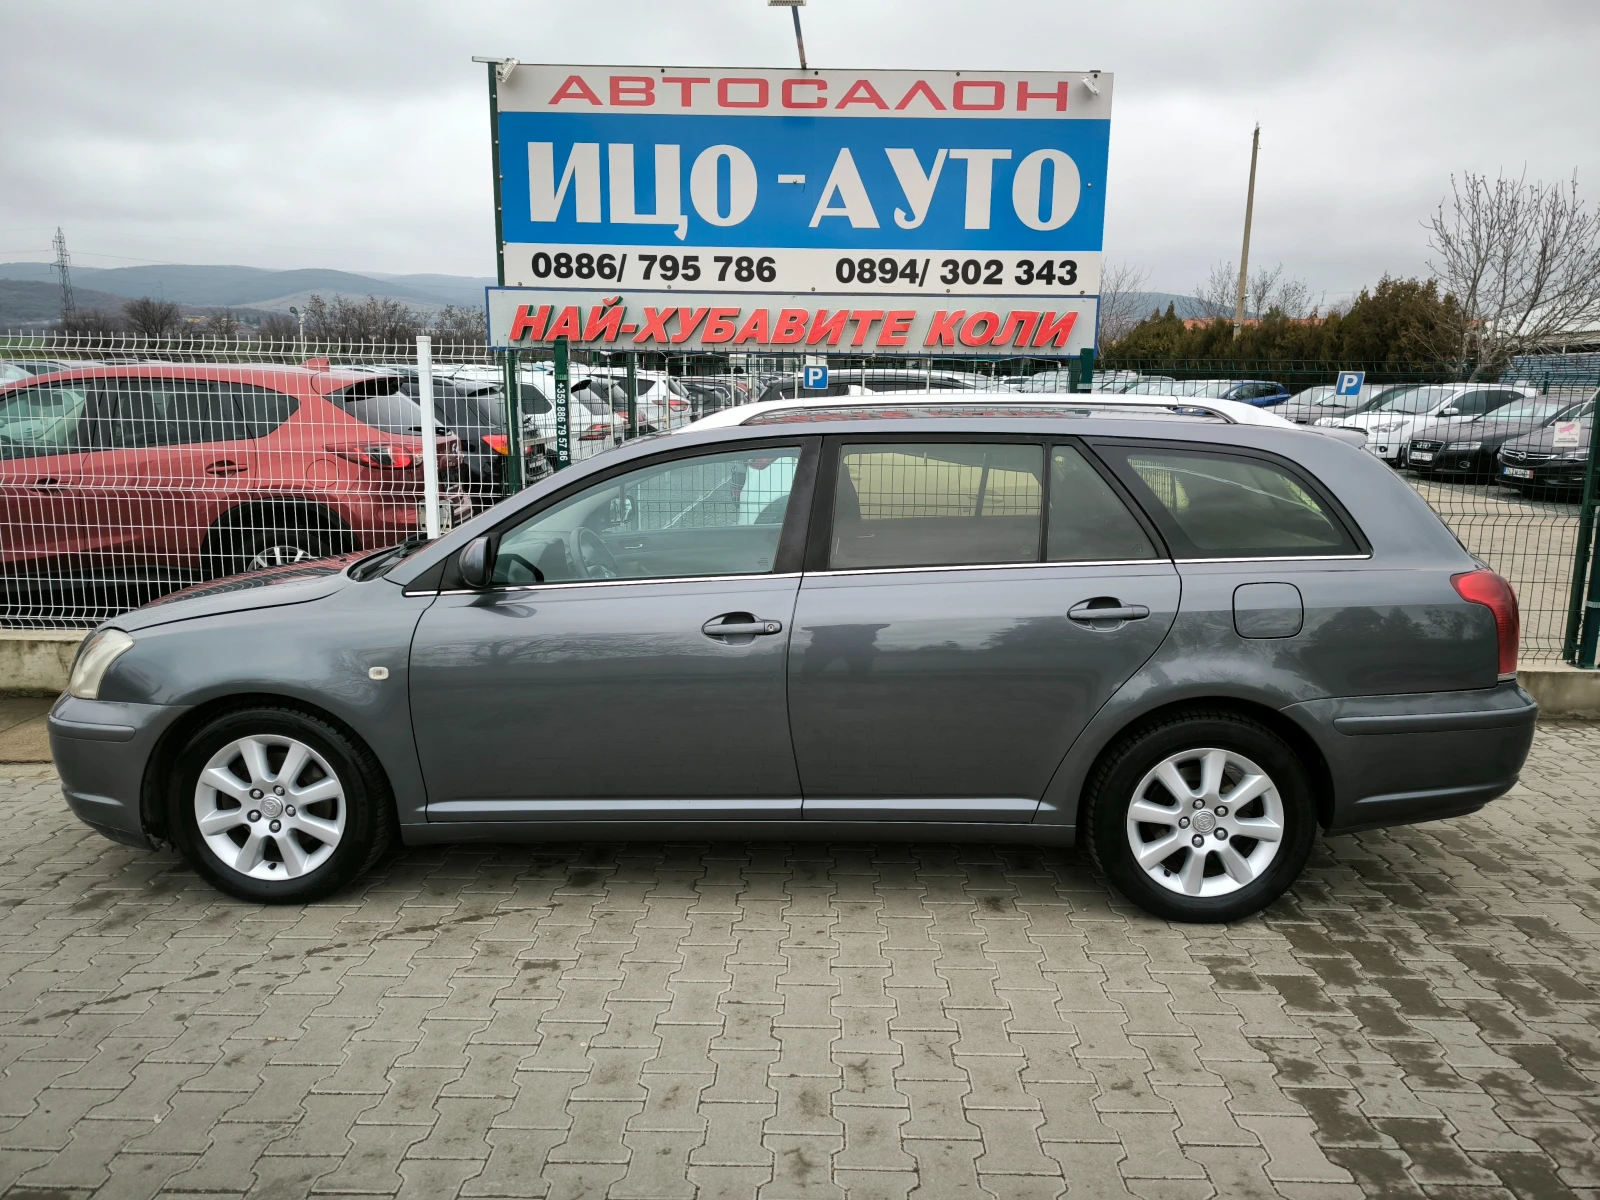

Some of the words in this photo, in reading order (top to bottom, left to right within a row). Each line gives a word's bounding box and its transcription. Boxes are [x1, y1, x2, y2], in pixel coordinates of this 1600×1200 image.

[548, 75, 1069, 112] АВТОСАЛОН
[531, 252, 628, 283] 0886/
[638, 254, 701, 282] 795
[713, 256, 777, 283] 786
[835, 257, 931, 287] 0894/
[939, 259, 1004, 285] 302
[1014, 260, 1078, 286] 343
[508, 296, 917, 347] НАЙ-ХУБАВИТЕ
[922, 309, 1079, 348] КОЛИ
[557, 382, 566, 404] +359
[557, 406, 566, 422] 886
[558, 424, 567, 436] 79
[558, 437, 568, 448] 57
[559, 450, 568, 461] 86
